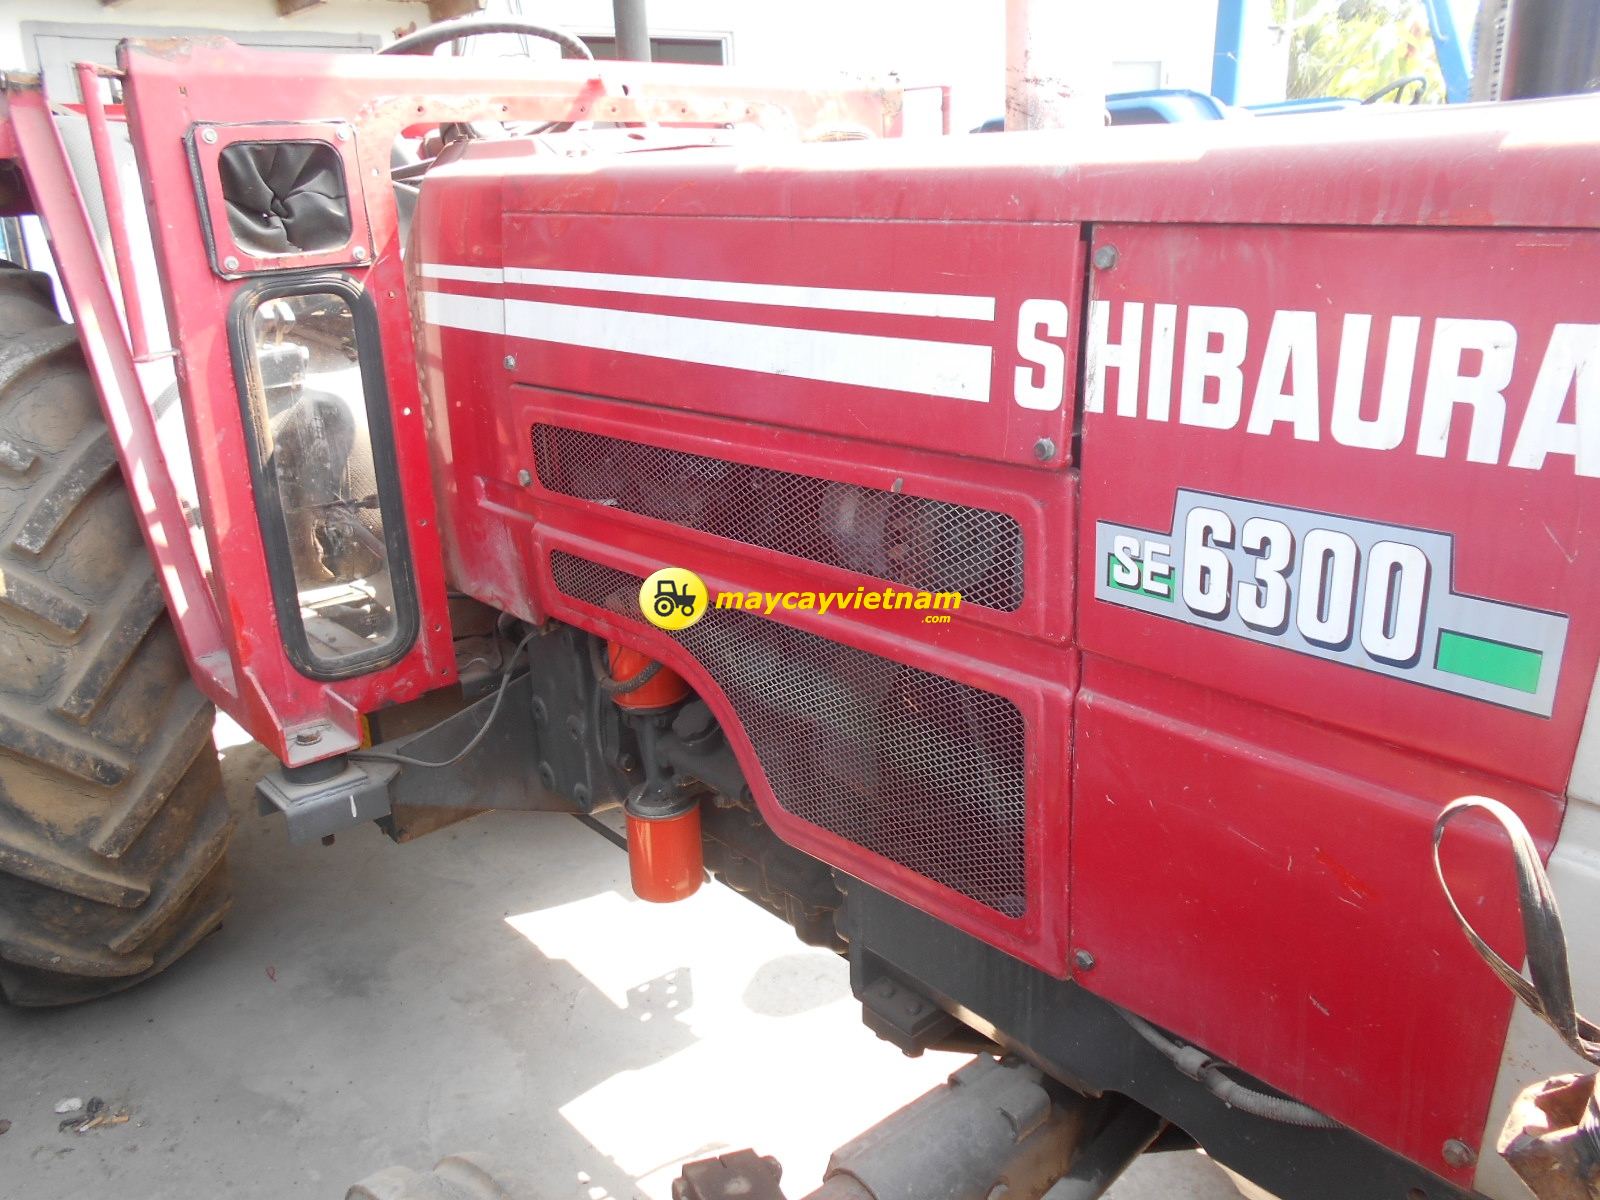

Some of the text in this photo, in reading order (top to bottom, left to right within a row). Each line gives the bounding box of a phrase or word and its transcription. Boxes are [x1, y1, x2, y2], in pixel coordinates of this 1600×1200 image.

[1014, 298, 1600, 478] SHIBAURA
[1112, 506, 1432, 669] SE 6300
